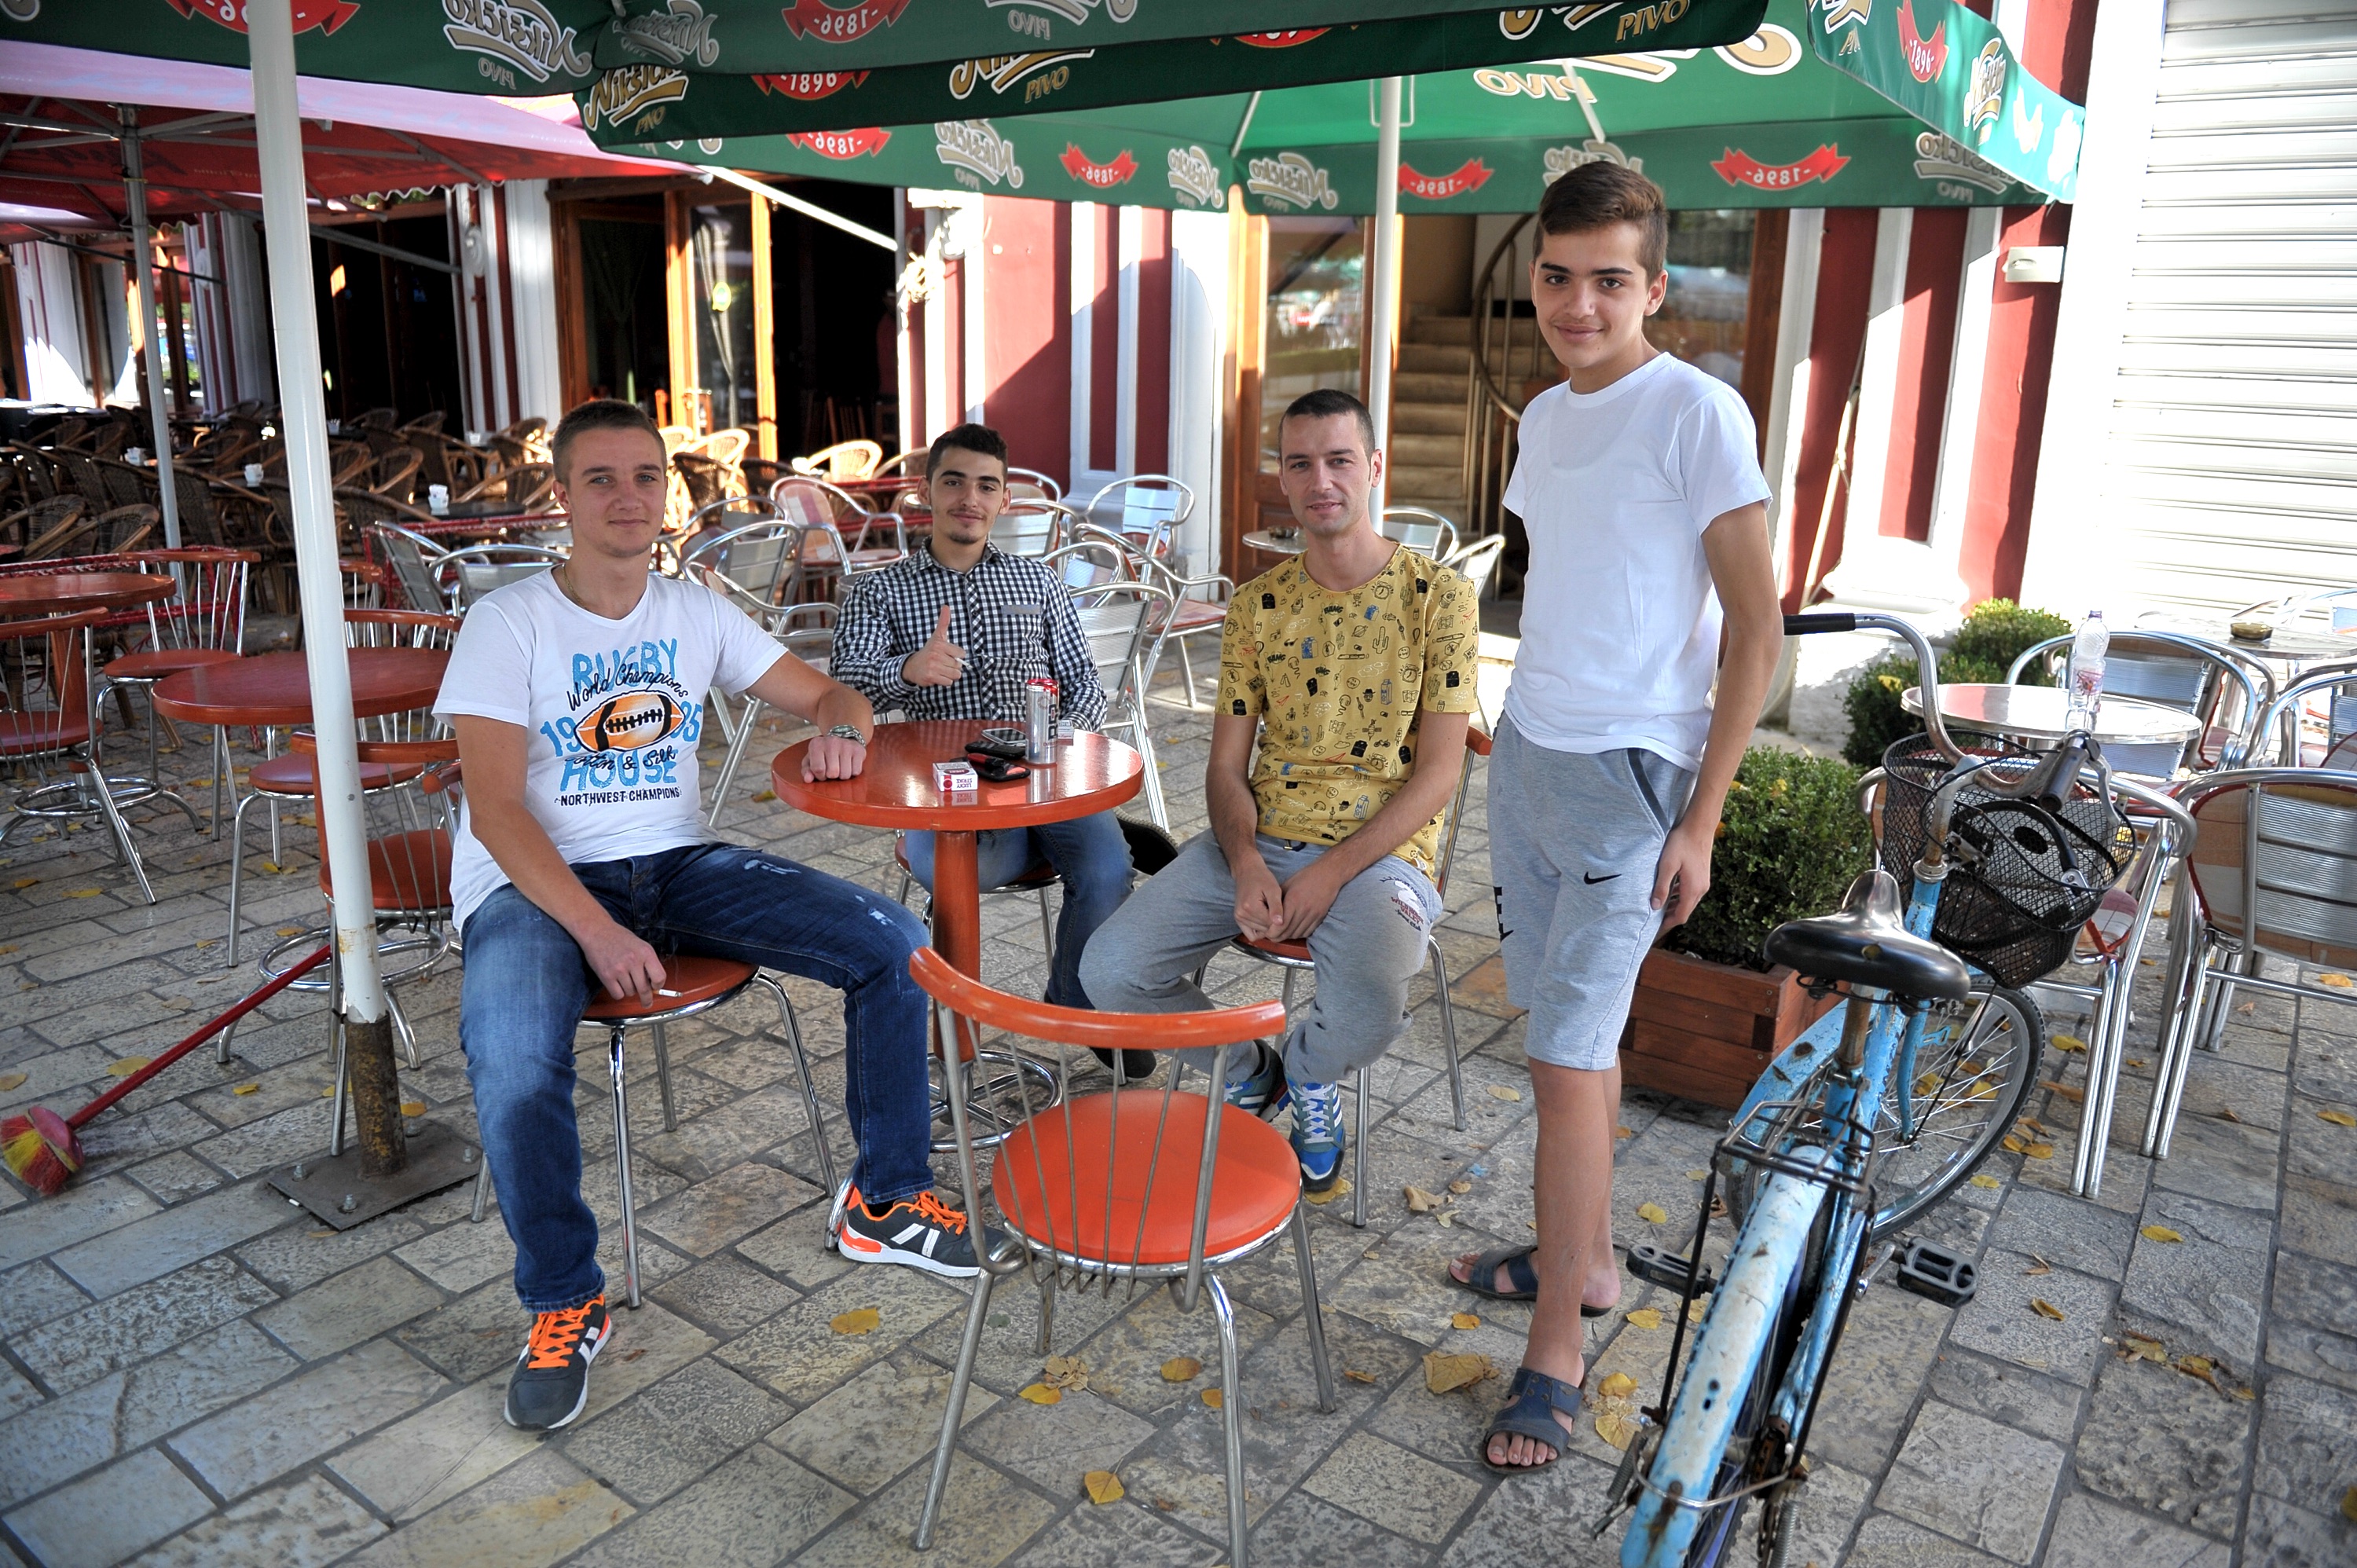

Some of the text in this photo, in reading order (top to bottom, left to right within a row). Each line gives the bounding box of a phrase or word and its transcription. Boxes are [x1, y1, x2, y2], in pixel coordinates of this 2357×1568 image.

[1615, 0, 1690, 42] PIVO
[1025, 66, 1069, 104] PIVO
[572, 638, 677, 694] RUGBY
[566, 664, 688, 711] World Champions
[559, 749, 679, 791] HOUSE
[623, 756, 637, 770] &
[643, 746, 676, 767] Silk
[560, 786, 680, 807] NORTHWEST CHAMPIONS
